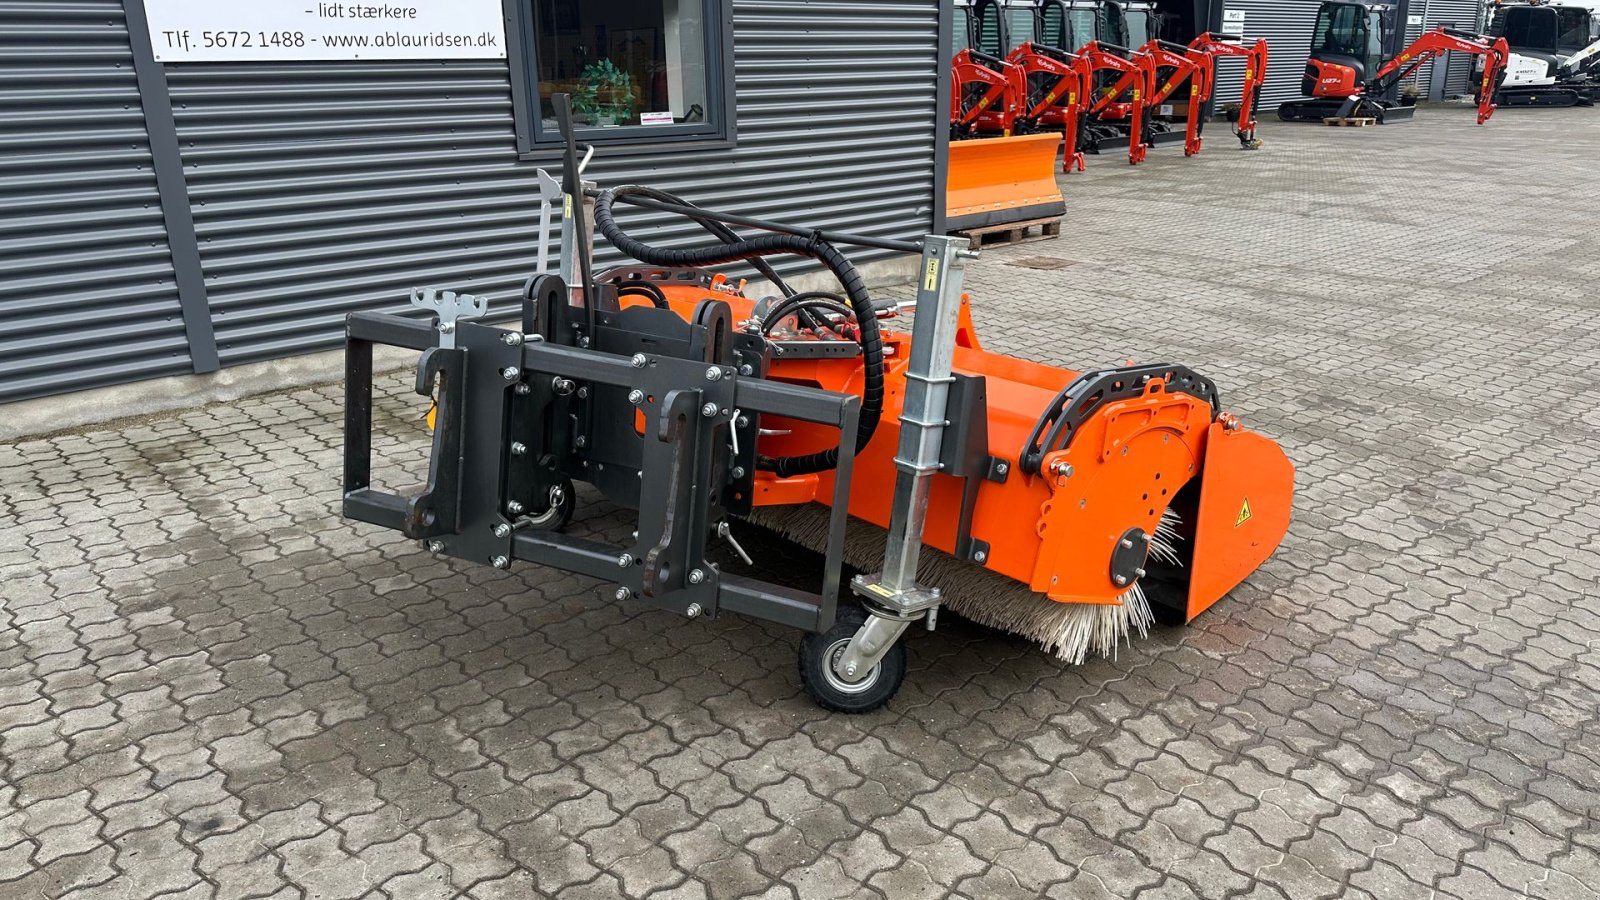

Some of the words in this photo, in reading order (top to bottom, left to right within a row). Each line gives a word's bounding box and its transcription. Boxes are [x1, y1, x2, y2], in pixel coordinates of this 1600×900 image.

[318, 2, 344, 18] lidt
[348, 3, 417, 19] stærkere
[163, 31, 197, 52] Tlf.
[203, 31, 252, 48] 5672
[258, 31, 305, 48] 1488
[322, 31, 497, 48] www.ablauridsen.dk
[1036, 59, 1056, 71] Kubota
[1102, 56, 1121, 69] Kubota
[1162, 54, 1180, 66] Kubota
